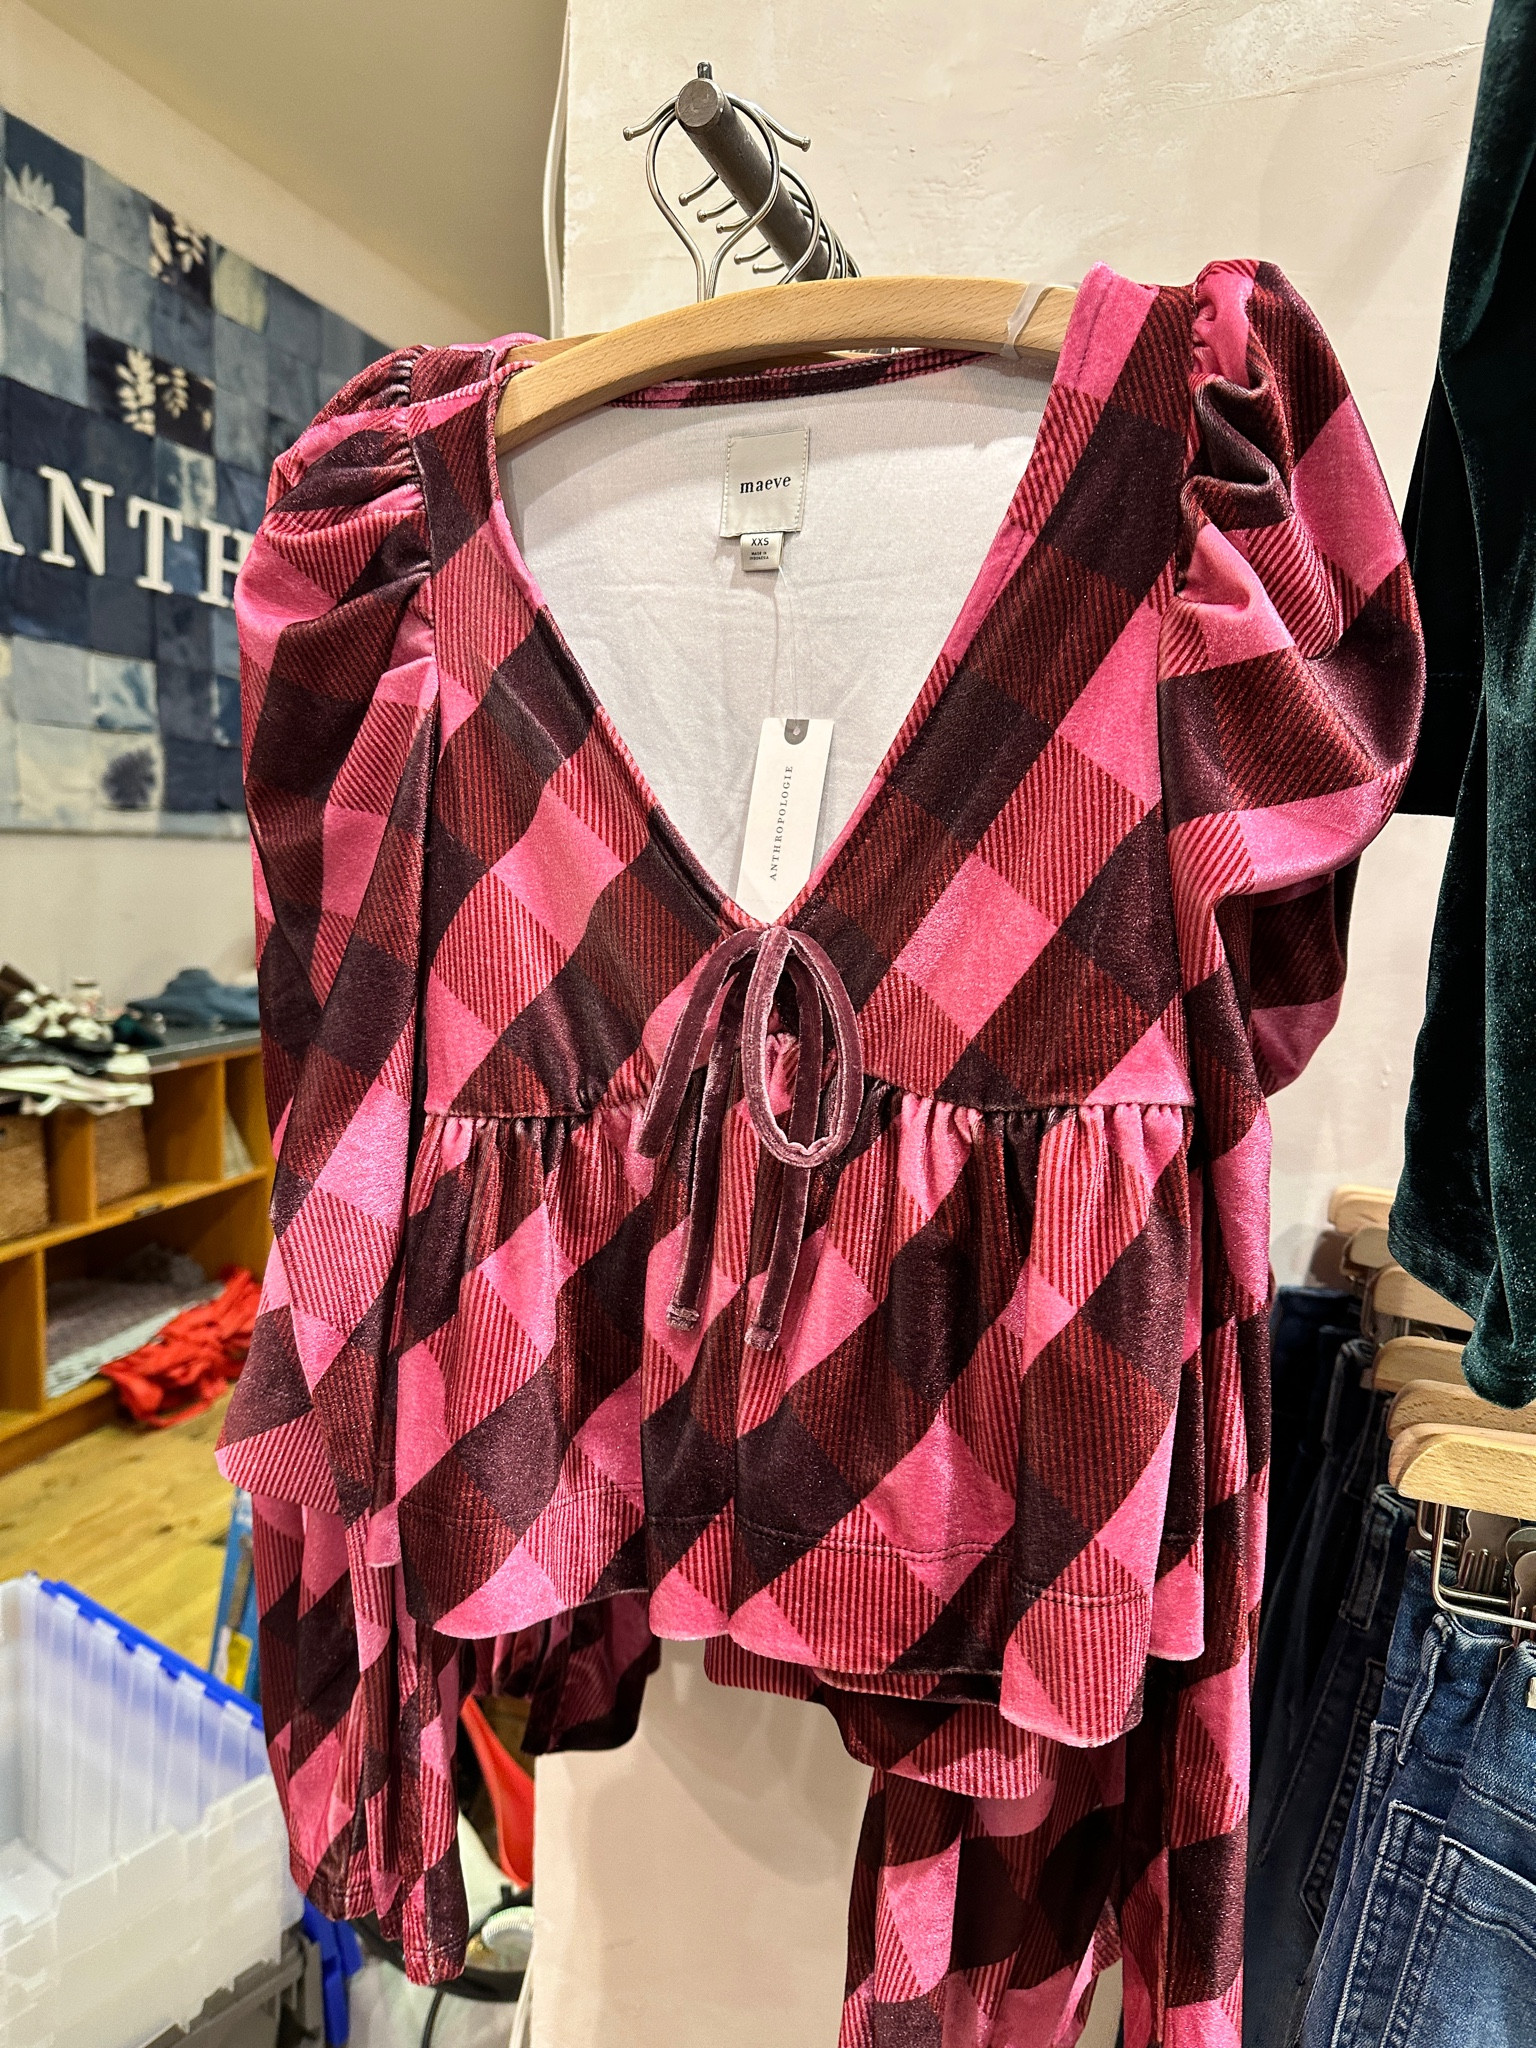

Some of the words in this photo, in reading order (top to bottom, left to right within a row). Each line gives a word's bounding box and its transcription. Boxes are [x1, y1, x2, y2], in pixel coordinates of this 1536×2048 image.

[740, 476, 791, 493] maeve
[751, 537, 769, 546] XXS
[769, 766, 793, 881] ANTHROPOLOGIE
